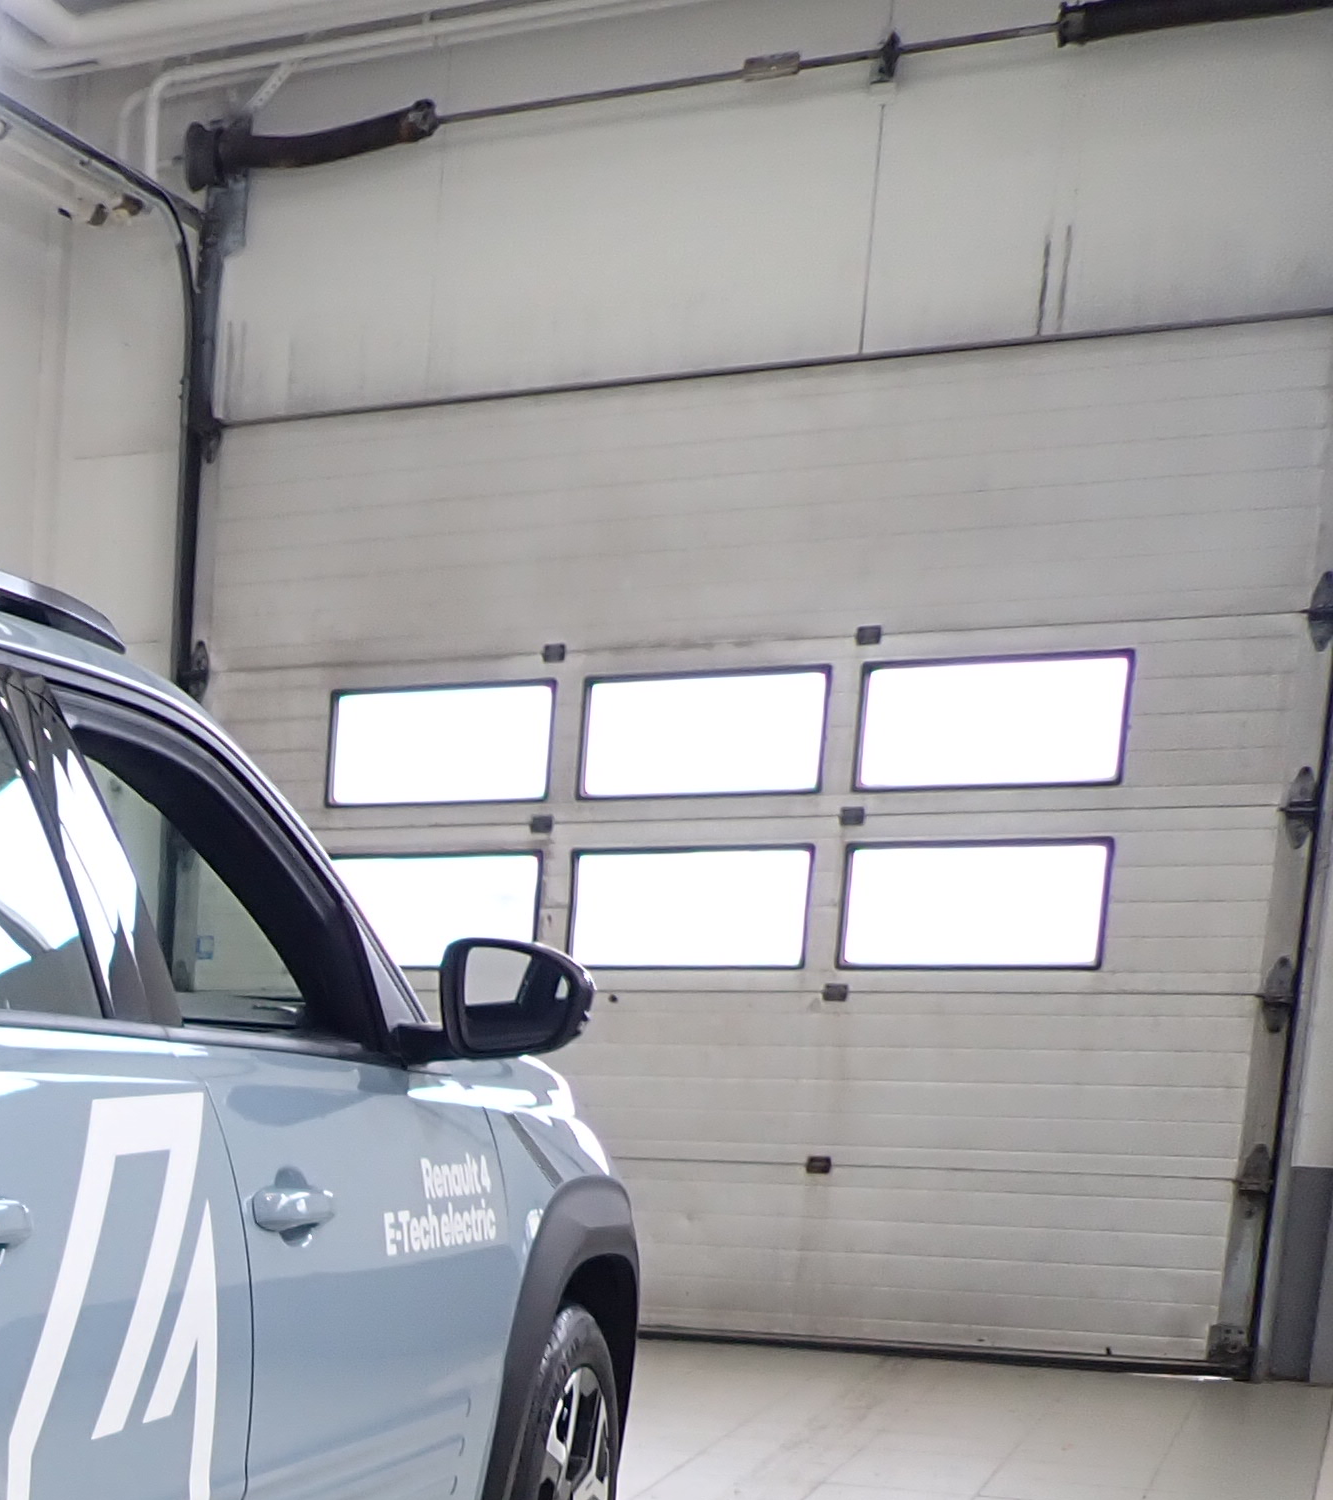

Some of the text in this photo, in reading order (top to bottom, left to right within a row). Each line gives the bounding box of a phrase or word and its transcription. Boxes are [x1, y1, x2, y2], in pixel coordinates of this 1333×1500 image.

[420, 1152, 491, 1199] Renault 4
[383, 1198, 497, 1256] E-Tech electric
